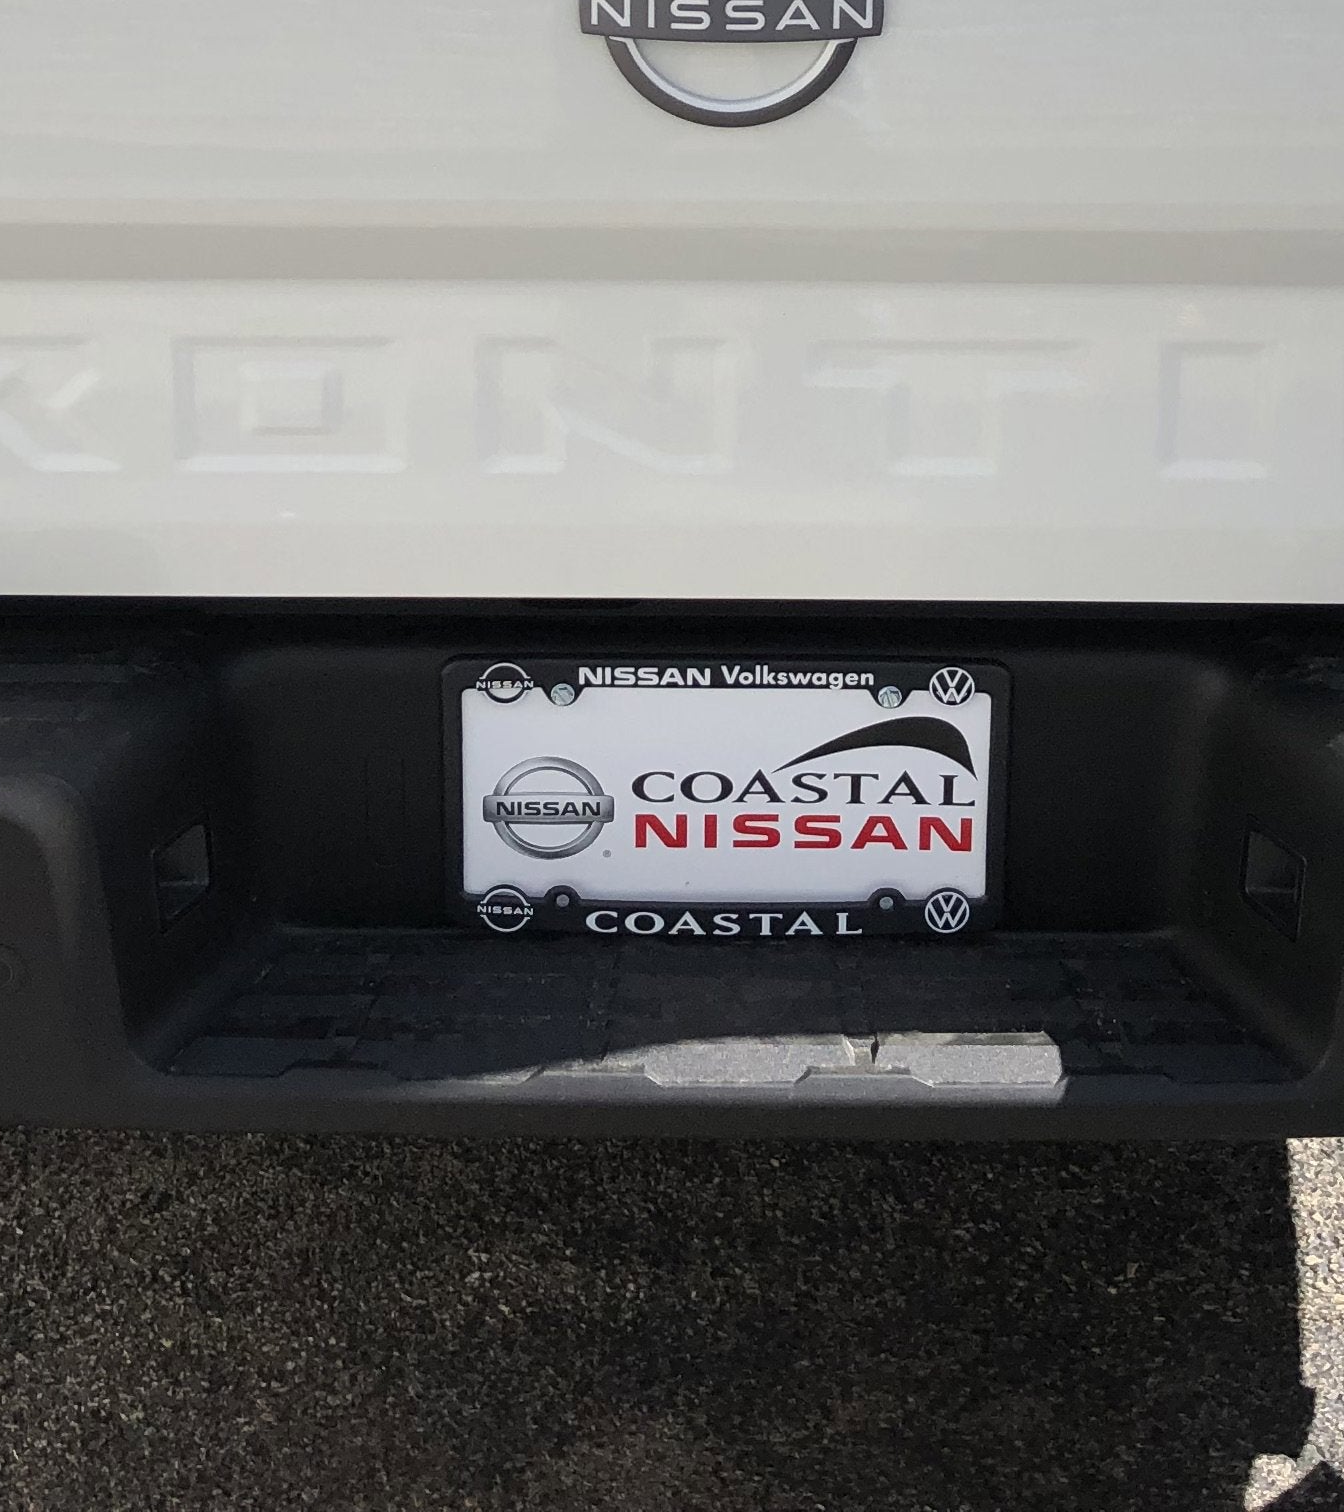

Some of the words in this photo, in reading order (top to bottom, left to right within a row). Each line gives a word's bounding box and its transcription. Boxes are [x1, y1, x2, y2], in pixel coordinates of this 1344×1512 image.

[476, 680, 535, 689] NISSAN
[578, 667, 712, 686] NISSAN
[721, 665, 875, 689] Volkswagen
[631, 769, 977, 808] COASTAL
[496, 801, 601, 816] NISSAN
[634, 814, 973, 853] NISSAN
[476, 904, 534, 916] NISSAN
[585, 910, 864, 936] COASTAL
